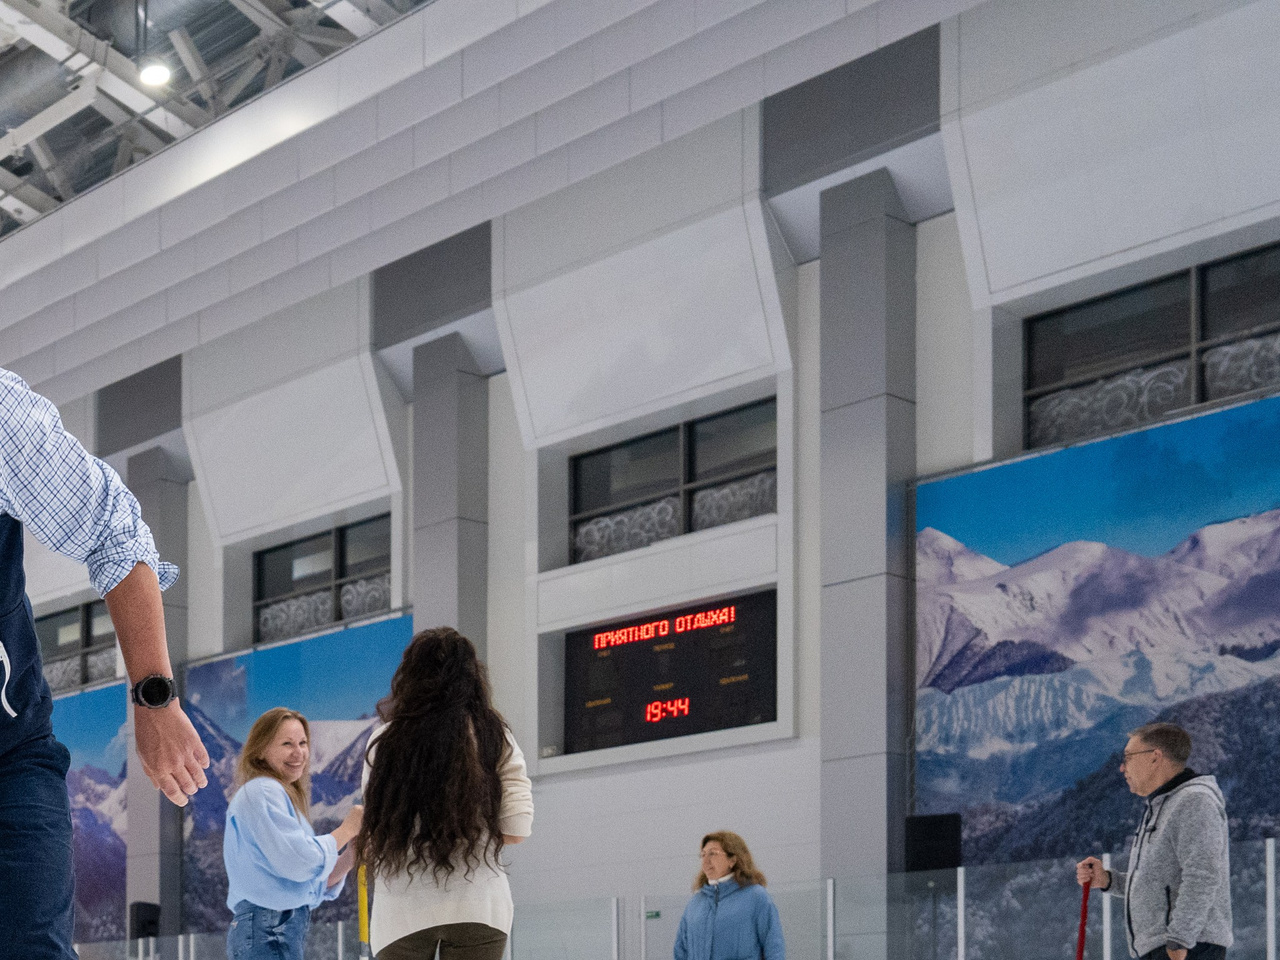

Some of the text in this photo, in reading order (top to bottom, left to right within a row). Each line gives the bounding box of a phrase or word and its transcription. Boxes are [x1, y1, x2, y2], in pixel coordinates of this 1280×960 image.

[593, 605, 736, 649] ПРИЯТНОГО ОТДЫХА!
[645, 698, 690, 722] 19:44
